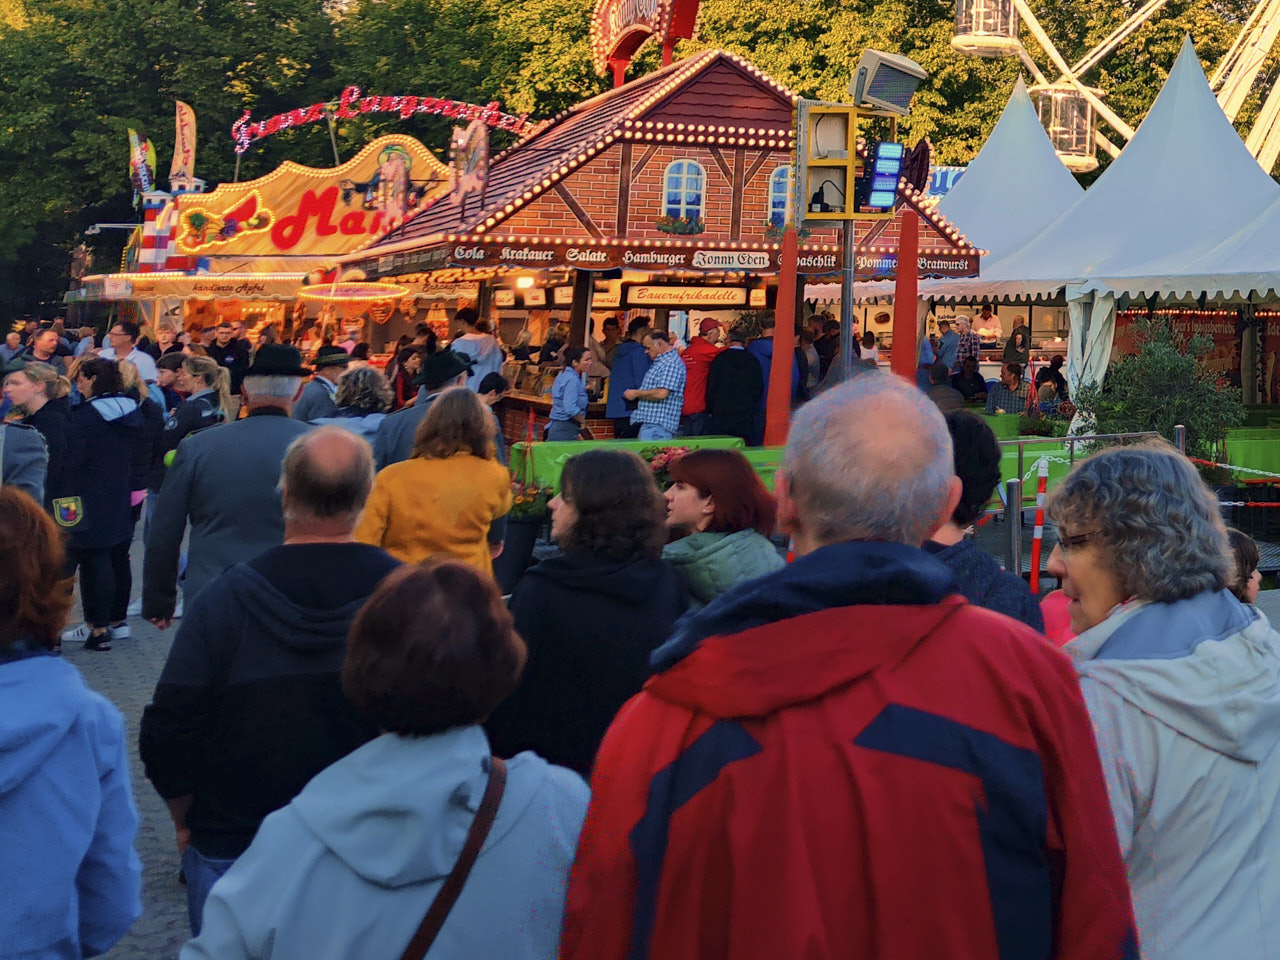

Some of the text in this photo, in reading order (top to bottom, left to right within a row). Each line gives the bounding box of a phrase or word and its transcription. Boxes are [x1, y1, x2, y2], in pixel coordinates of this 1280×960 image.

[454, 245, 486, 260] Cola
[500, 246, 555, 261] Krakauer
[565, 247, 607, 262] Salate
[622, 250, 686, 266] Hamburger
[695, 252, 734, 266] Jonny
[737, 252, 766, 266] Eden
[856, 255, 899, 270] Pomme
[917, 256, 969, 271] Bratwurst
[637, 287, 738, 303] Bauernfrikadelle
